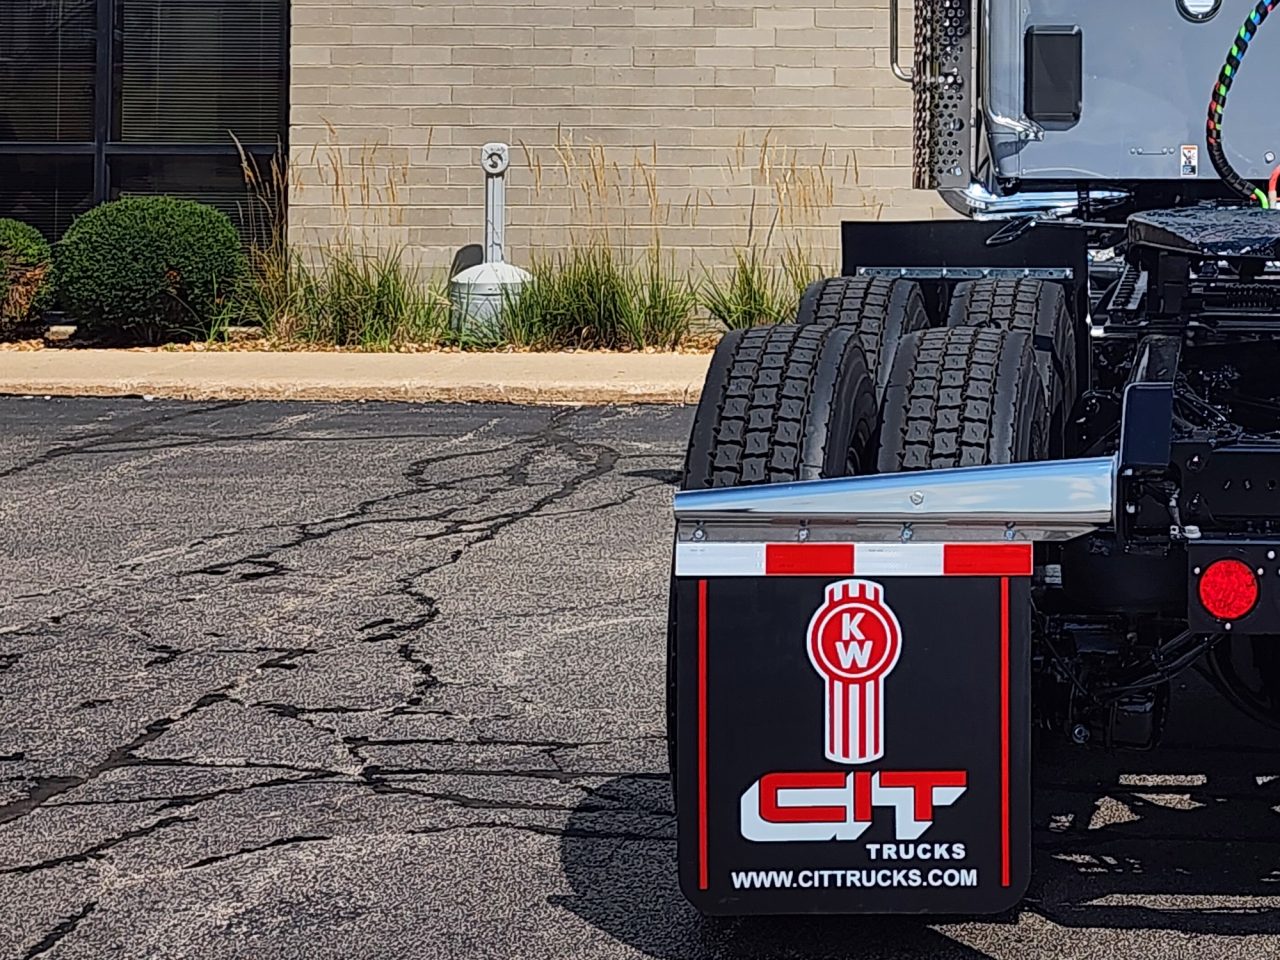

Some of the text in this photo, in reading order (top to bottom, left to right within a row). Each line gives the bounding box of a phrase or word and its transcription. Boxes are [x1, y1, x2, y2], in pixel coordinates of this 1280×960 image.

[741, 771, 967, 841] CIT
[866, 843, 966, 860] TRUCKS
[731, 869, 978, 889] WWW.CITTRUCKS.COM
